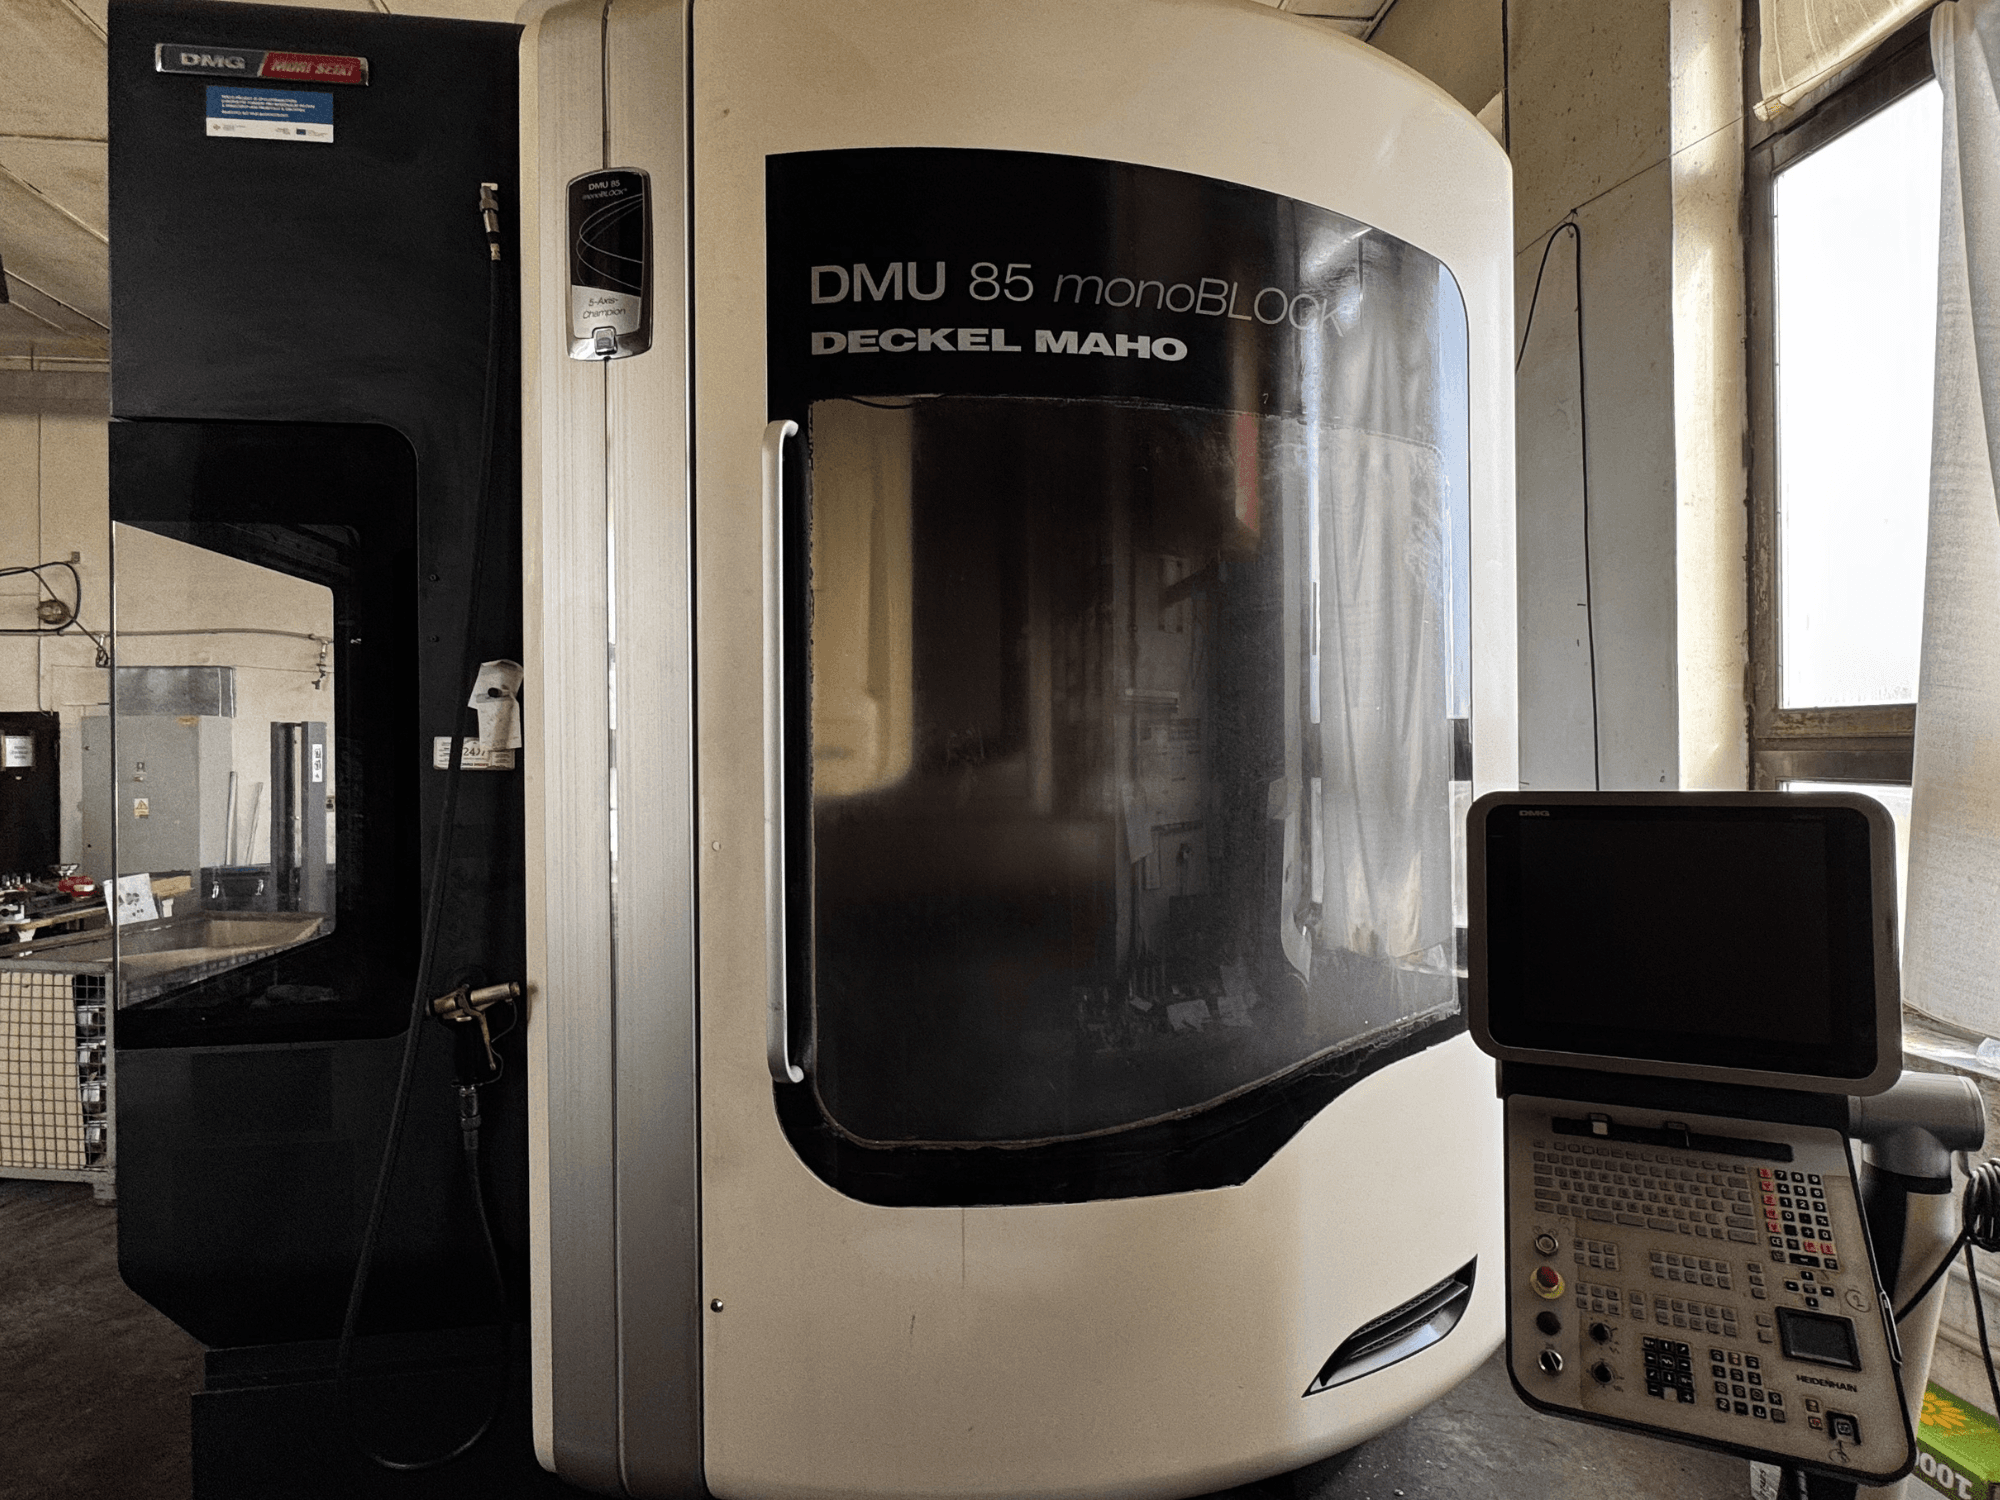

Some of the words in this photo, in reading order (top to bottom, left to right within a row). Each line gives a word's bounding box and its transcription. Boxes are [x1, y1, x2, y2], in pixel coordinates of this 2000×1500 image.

[181, 52, 246, 69] DMG
[588, 180, 609, 191] DMU
[810, 261, 946, 304] DMU
[968, 262, 1034, 302] 85
[582, 308, 626, 320] Champion
[811, 327, 1022, 355] DECKEL
[1035, 329, 1188, 361] MAHO
[1796, 1374, 1858, 1393] HEIDENHAIN
